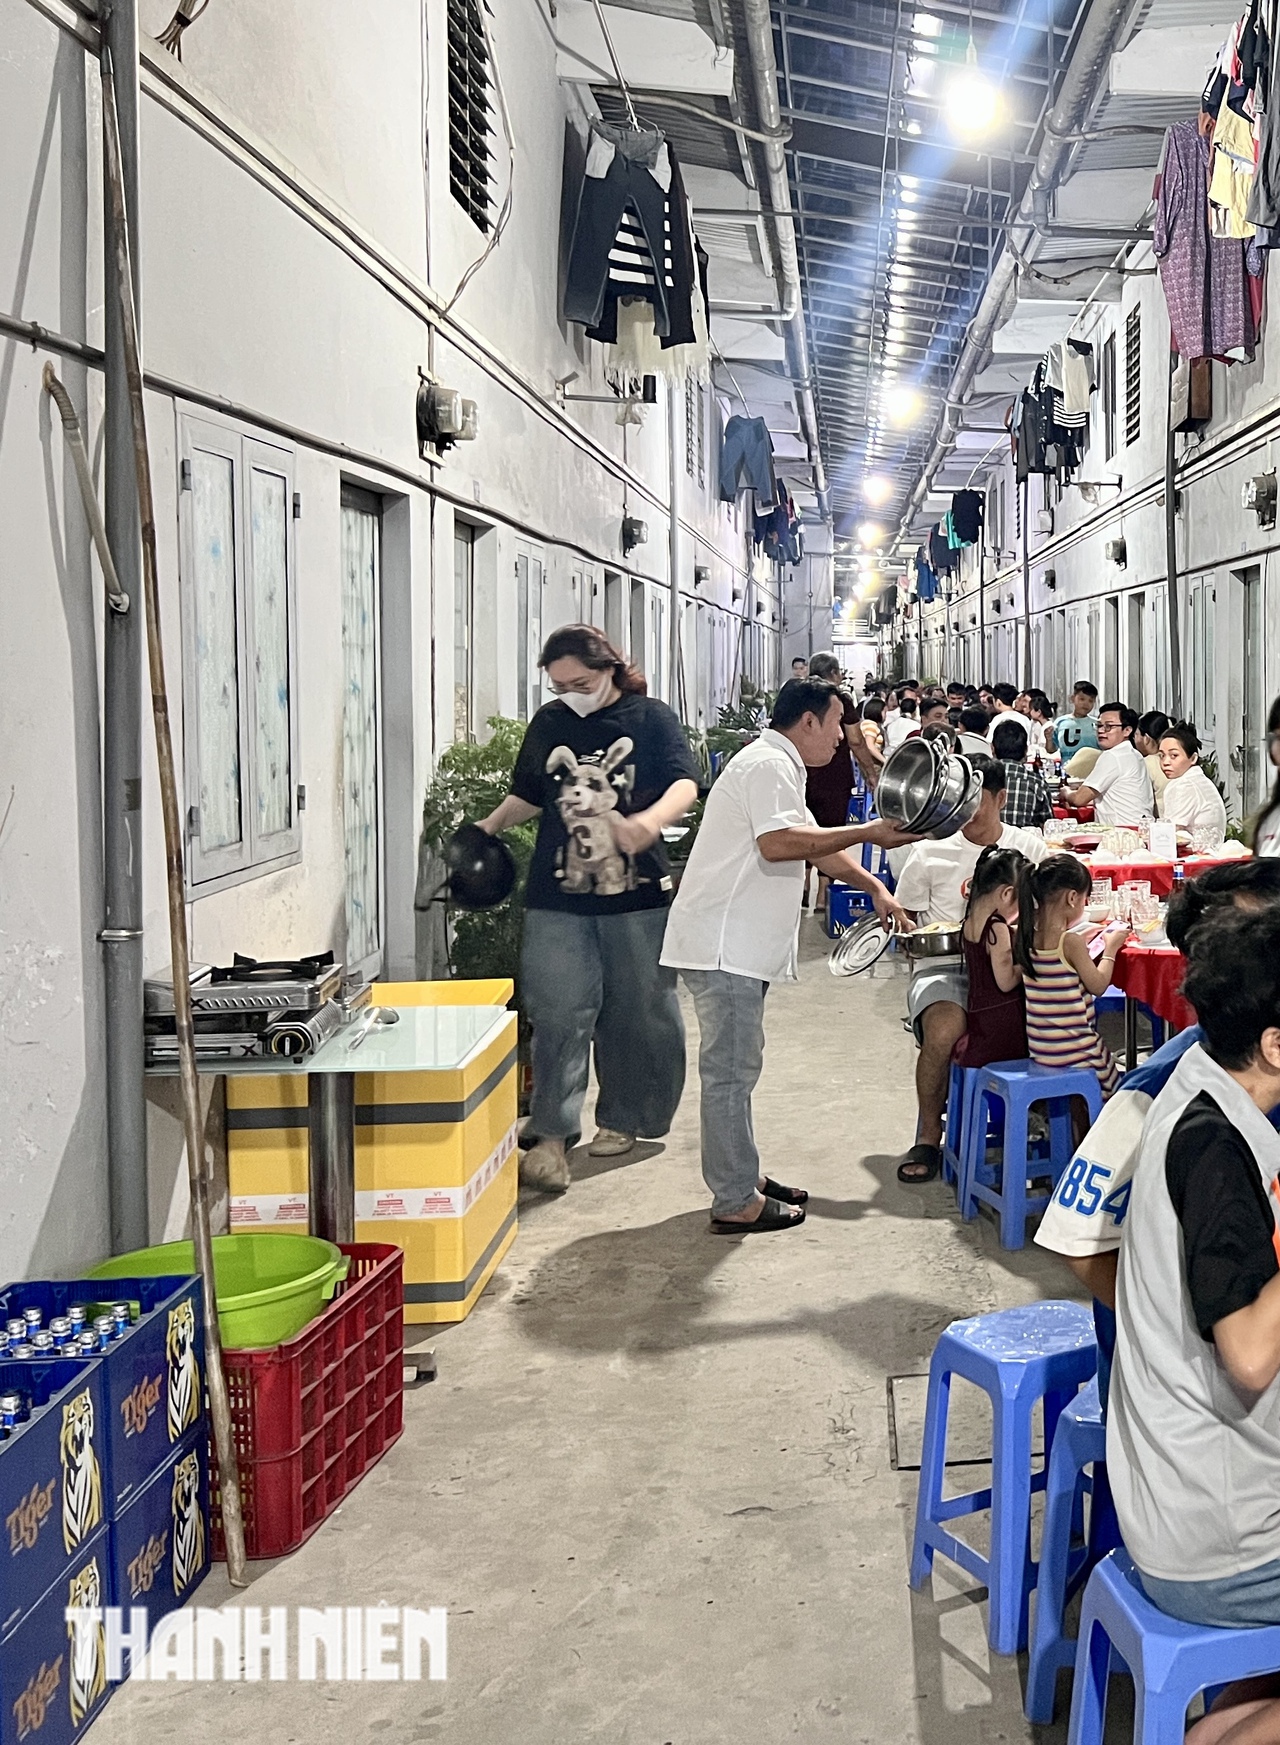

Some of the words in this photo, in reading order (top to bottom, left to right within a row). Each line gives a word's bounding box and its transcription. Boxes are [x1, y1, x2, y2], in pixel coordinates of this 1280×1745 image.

[1053, 1156, 1132, 1226] 854
[121, 1373, 163, 1434] Tiger
[5, 1477, 57, 1549] Tiger
[126, 1529, 169, 1595] Tiger
[12, 1653, 63, 1738] Tiger
